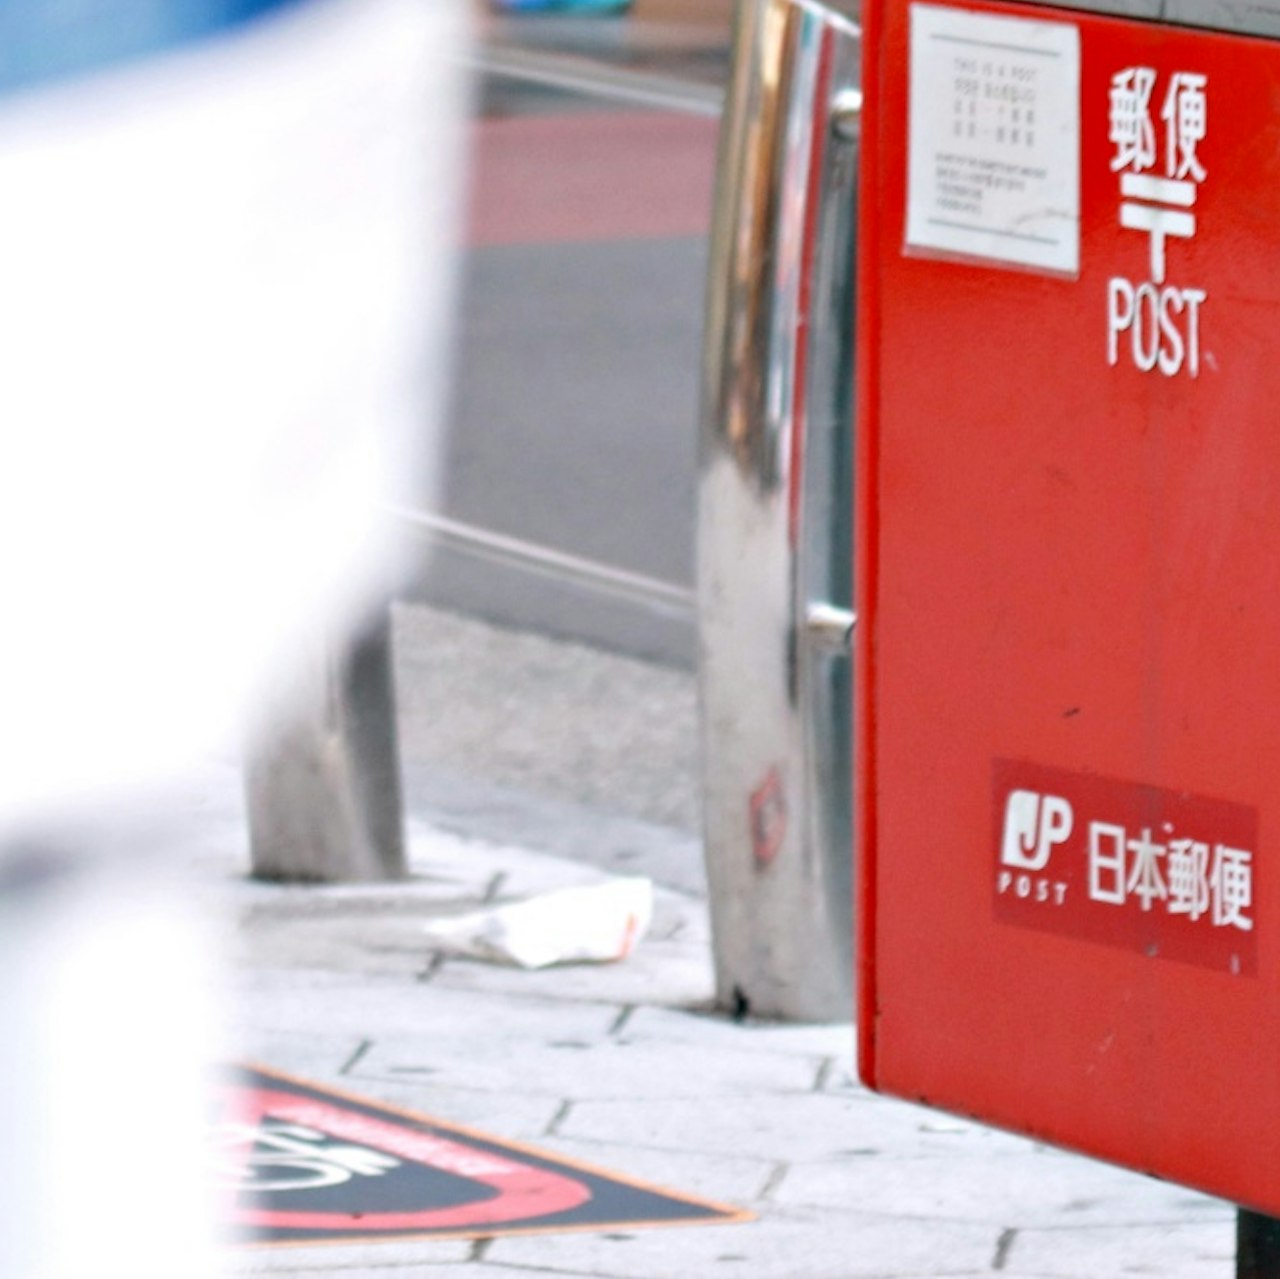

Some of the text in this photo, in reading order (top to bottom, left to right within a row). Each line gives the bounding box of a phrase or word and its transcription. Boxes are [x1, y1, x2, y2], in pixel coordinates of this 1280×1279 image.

[1109, 66, 1207, 182] 郵便
[1107, 276, 1206, 380] POST
[997, 871, 1068, 906] POST
[1088, 821, 1254, 931] 日本郵便
